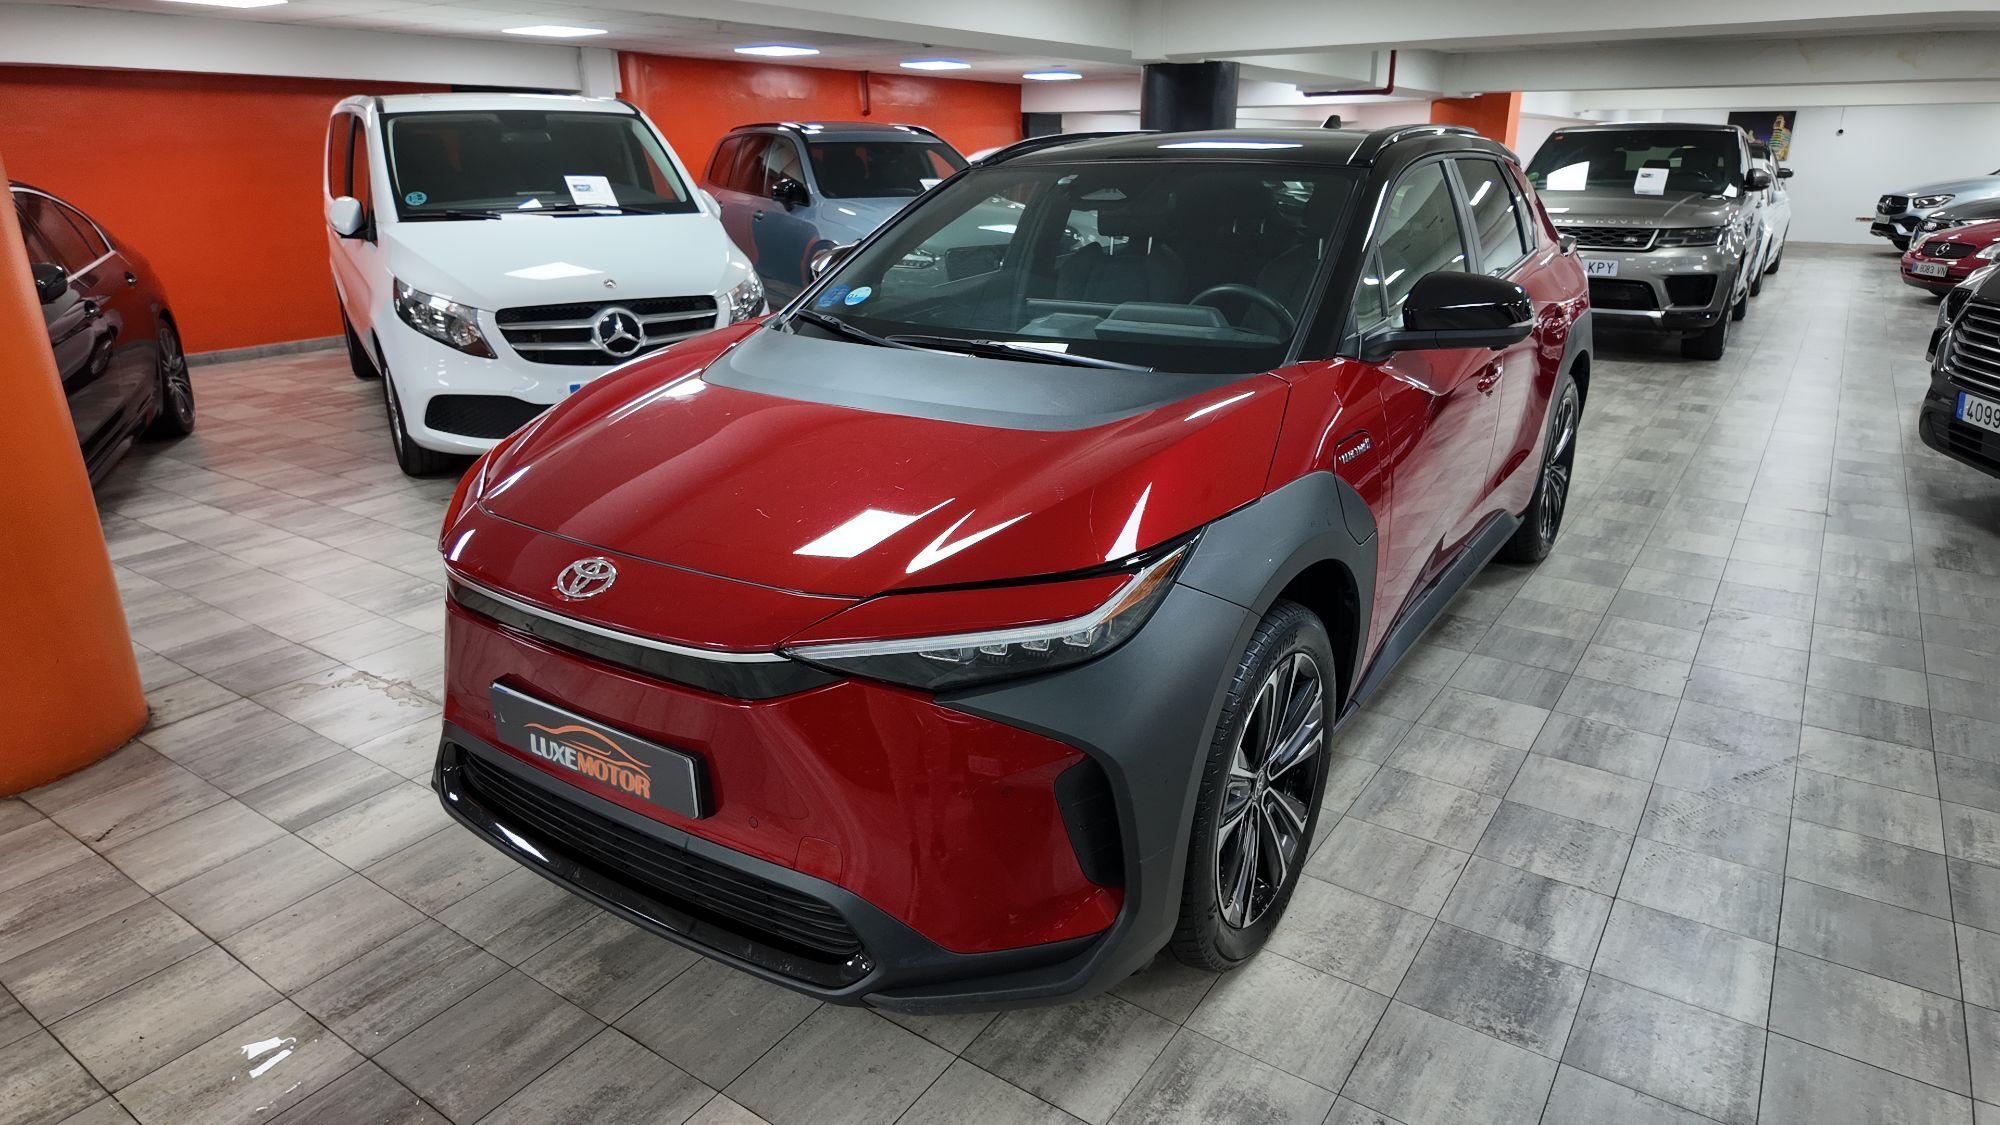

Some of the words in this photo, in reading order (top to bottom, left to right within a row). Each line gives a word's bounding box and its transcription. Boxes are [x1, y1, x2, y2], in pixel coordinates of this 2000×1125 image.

[1588, 261, 1615, 274] KPY
[1966, 400, 2000, 429] 4099
[529, 733, 650, 799] LUXEMOTOR
